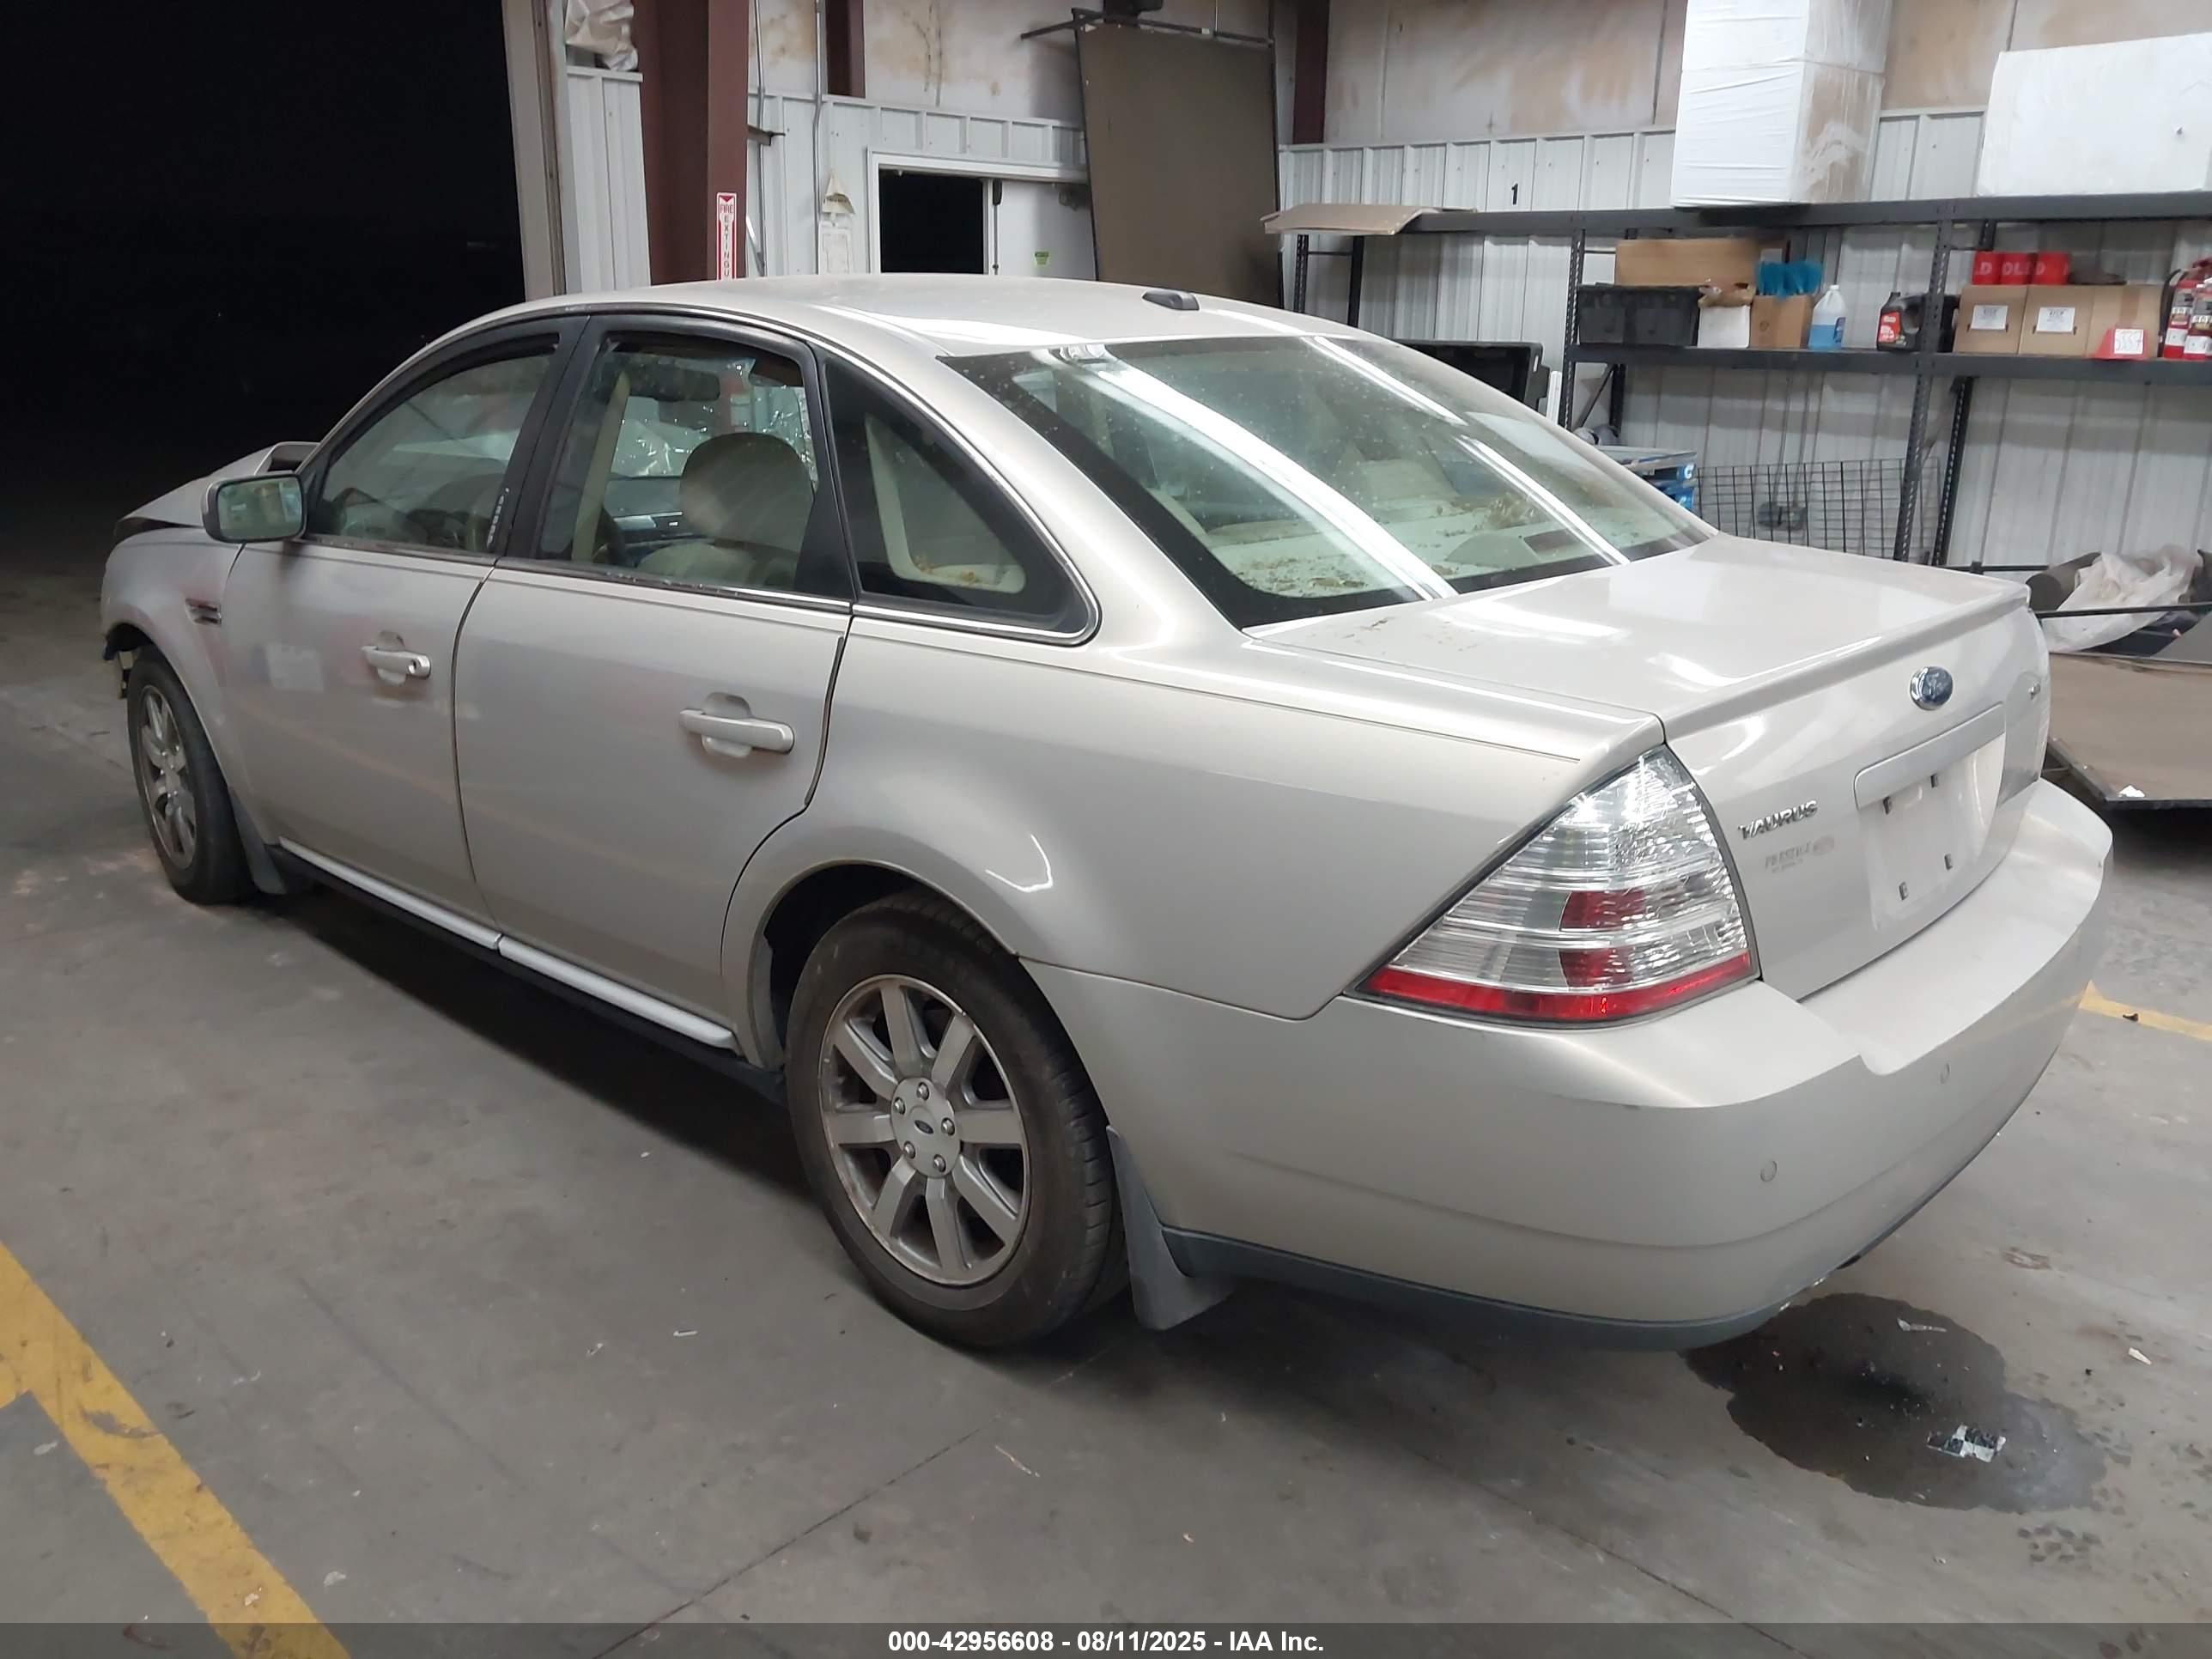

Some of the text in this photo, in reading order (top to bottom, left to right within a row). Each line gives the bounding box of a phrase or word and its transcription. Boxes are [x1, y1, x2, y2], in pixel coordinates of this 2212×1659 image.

[1510, 183, 1518, 205] 1
[720, 204, 733, 214] FIRE
[1737, 799, 1818, 840] TAURUS
